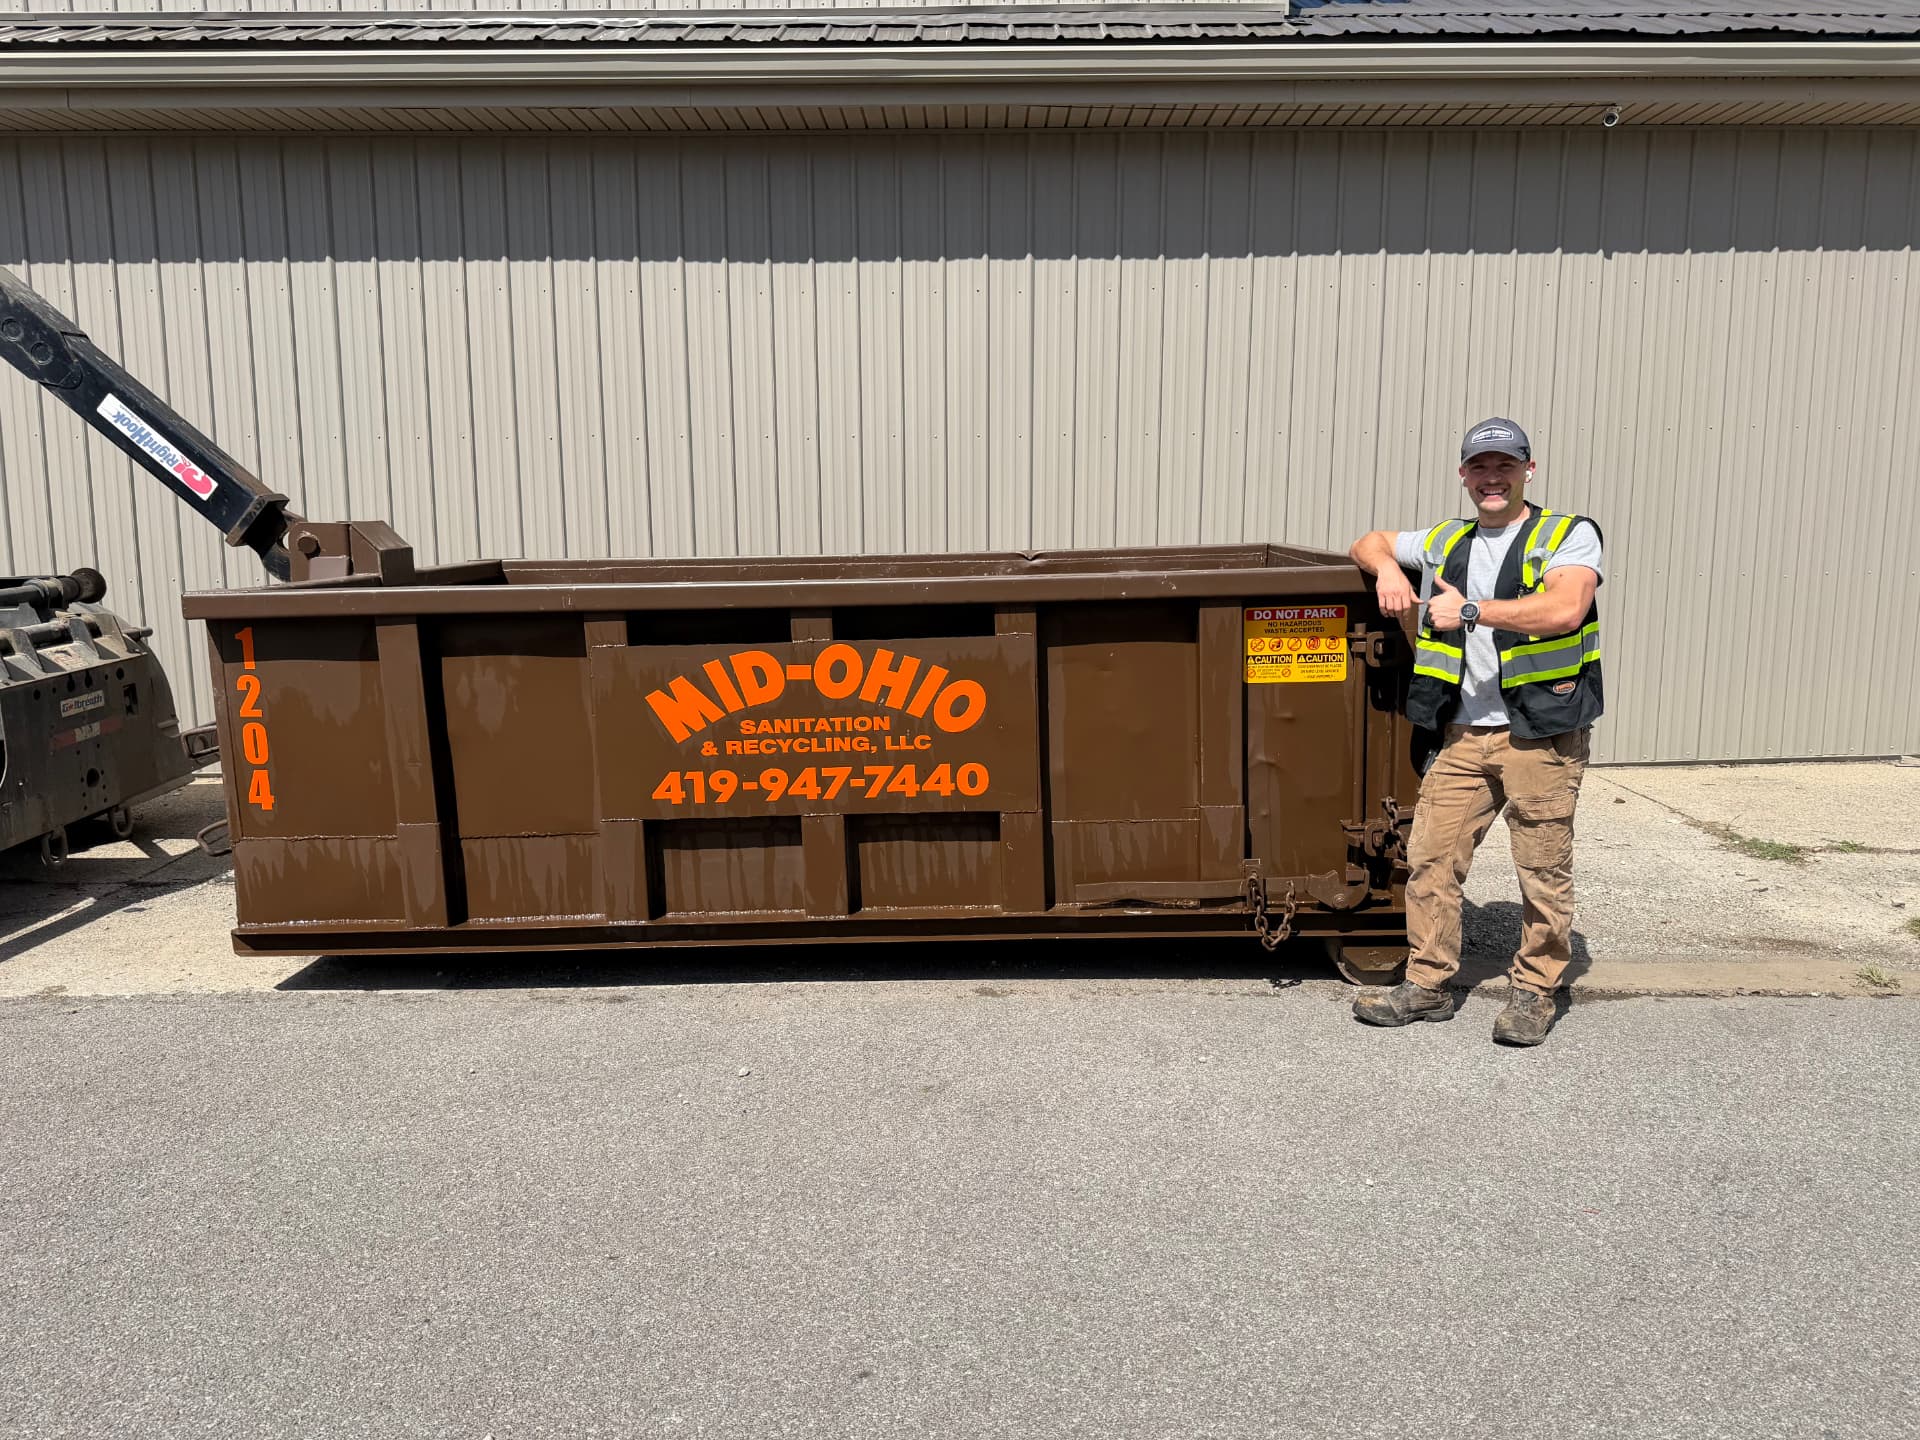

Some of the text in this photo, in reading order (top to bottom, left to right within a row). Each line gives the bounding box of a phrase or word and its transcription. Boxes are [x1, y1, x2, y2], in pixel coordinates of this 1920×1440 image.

[112, 410, 179, 467] RightHook
[1254, 608, 1337, 620] DO NOT PARK
[1255, 656, 1292, 664] CAUTION
[644, 643, 987, 744] MID-OHIO
[234, 626, 275, 811] 1204
[739, 715, 891, 735] SANITATION
[700, 734, 932, 757] & RECYCLING, LLC
[651, 762, 990, 805] 419-947-7440
